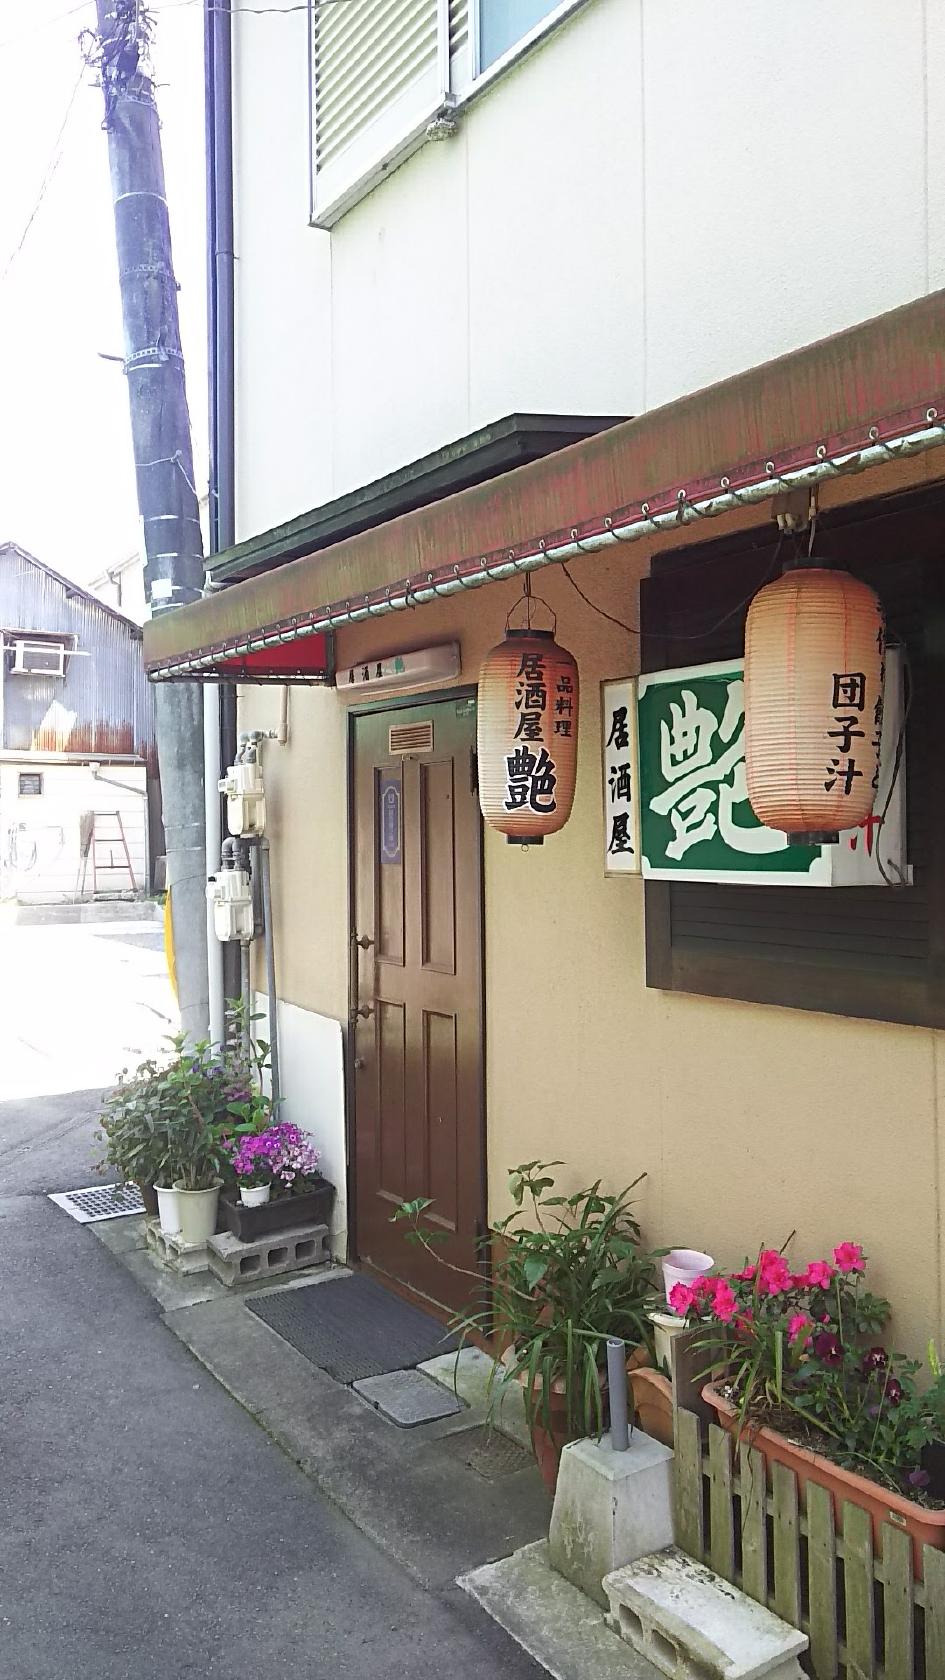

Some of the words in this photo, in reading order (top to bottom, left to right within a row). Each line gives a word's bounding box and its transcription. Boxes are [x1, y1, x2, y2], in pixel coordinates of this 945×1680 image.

[553, 661, 574, 738] 一品料理
[824, 672, 867, 795] 団子汁
[606, 706, 634, 855] 居酒屋
